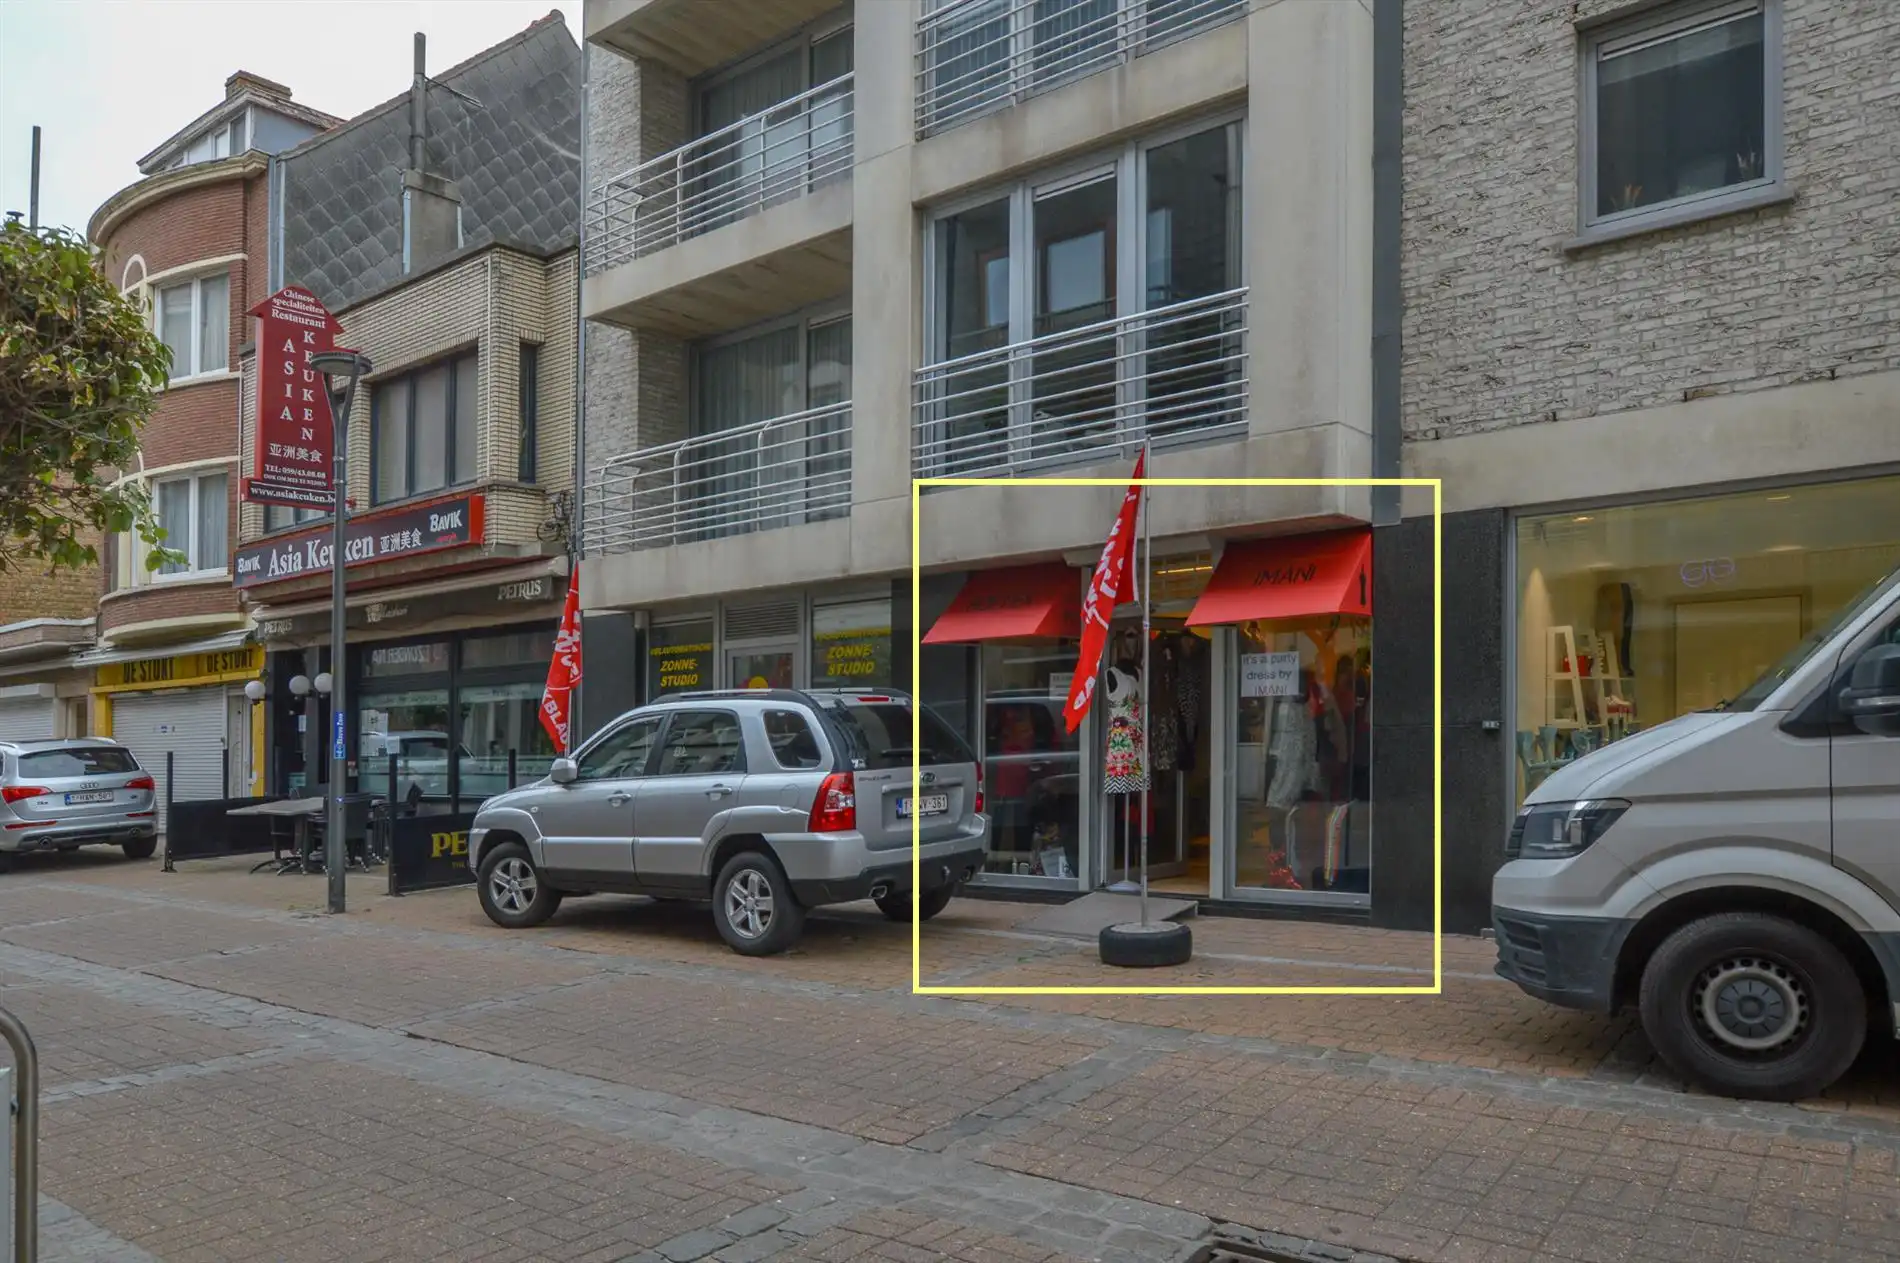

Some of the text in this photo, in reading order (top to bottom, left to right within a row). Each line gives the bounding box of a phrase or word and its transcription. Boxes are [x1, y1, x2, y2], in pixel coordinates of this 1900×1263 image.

[272, 298, 325, 314] specialiteiten
[283, 289, 315, 303] Chinese
[271, 308, 326, 329] Restaurant
[280, 338, 297, 421] ASIA
[268, 442, 323, 463] 亚洲美食
[264, 463, 282, 473] TEL:
[430, 509, 463, 532] BAVIK
[380, 528, 423, 554] 亚洲美食
[267, 543, 303, 577] Asia
[1253, 562, 1317, 586] IMANI
[498, 579, 542, 600] PETRUS
[264, 618, 293, 634] PETRUS
[123, 657, 175, 684] DE STUNT
[206, 648, 253, 673] DE STUNT
[827, 659, 876, 676] STUDIO
[660, 673, 698, 687] STUDIO
[1246, 669, 1292, 681] dress by
[1254, 684, 1288, 696] IMANI
